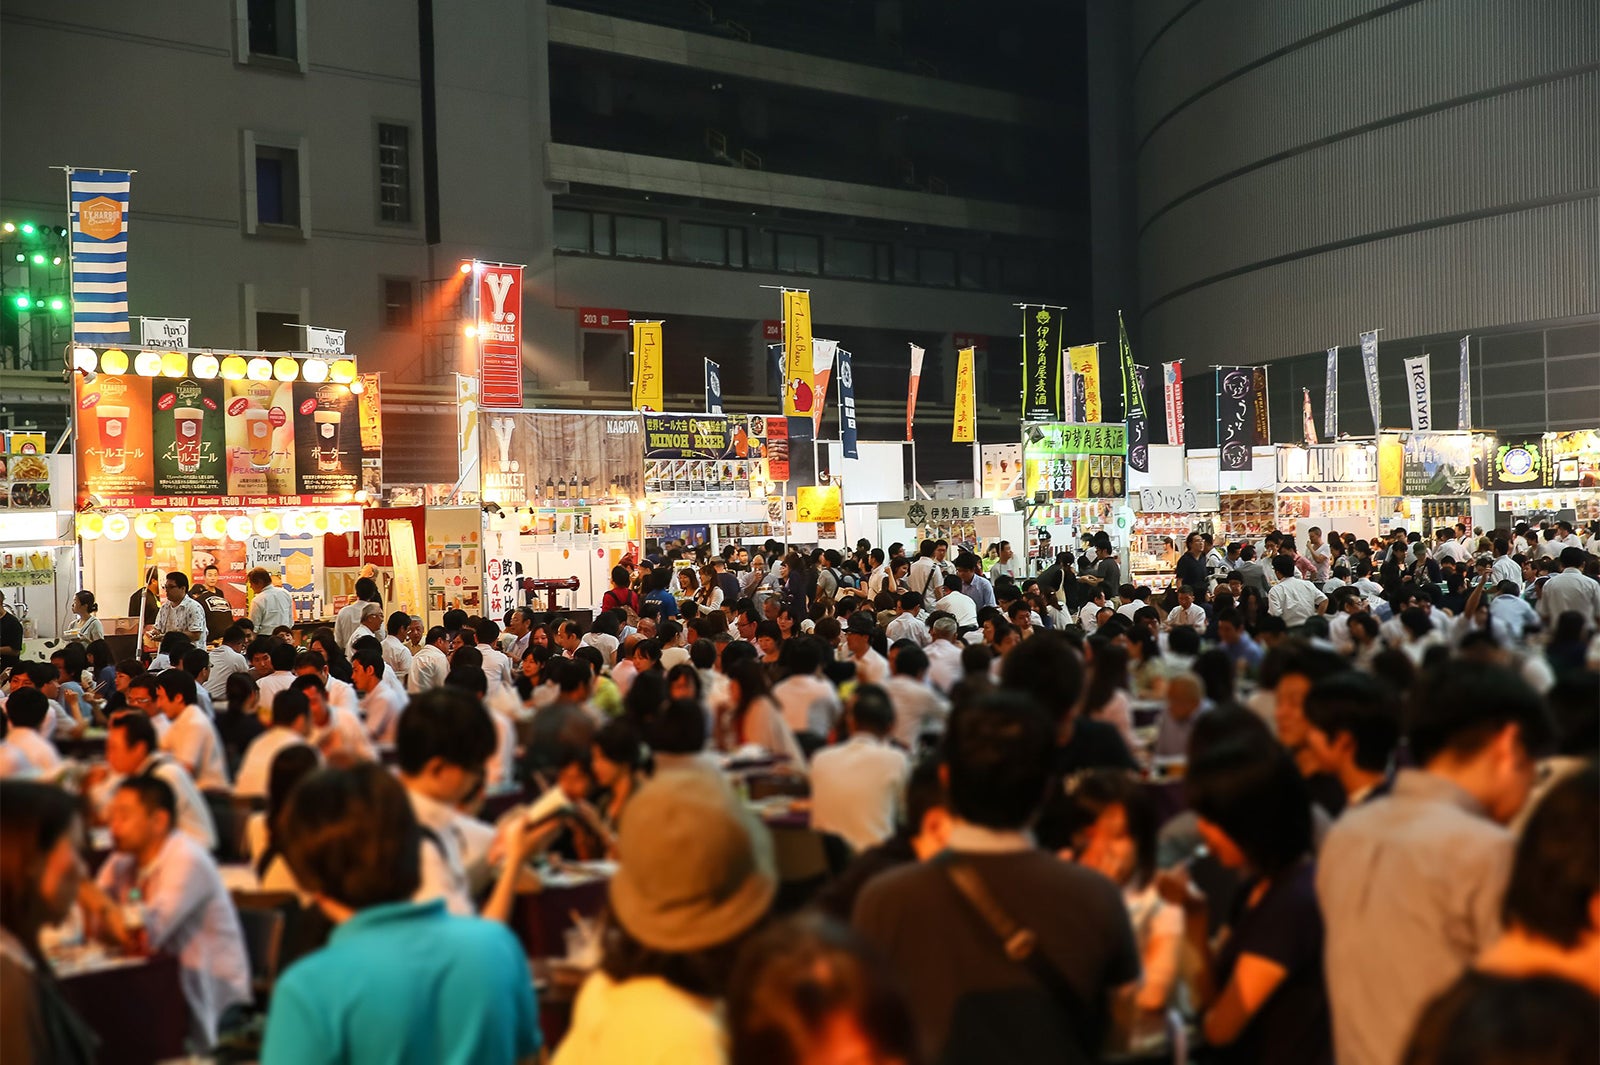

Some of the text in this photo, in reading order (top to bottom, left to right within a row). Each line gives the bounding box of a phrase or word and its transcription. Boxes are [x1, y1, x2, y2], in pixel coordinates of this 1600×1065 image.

[583, 314, 597, 324] 203
[767, 325, 779, 334] 204
[1035, 326, 1051, 406] 伊勢角屋麦酒
[606, 420, 639, 434] NAGOYA
[168, 440, 212, 452] インディア
[649, 434, 725, 449] MINOH BEER
[85, 447, 144, 459] ペールエール
[162, 451, 219, 463] ペールエール
[311, 447, 348, 459] ポーター
[1038, 460, 1072, 476] 世界大会
[168, 498, 188, 507] ¥300
[221, 497, 239, 506] ¥500
[279, 496, 301, 506] ¥1,000
[252, 538, 270, 550] Craft
